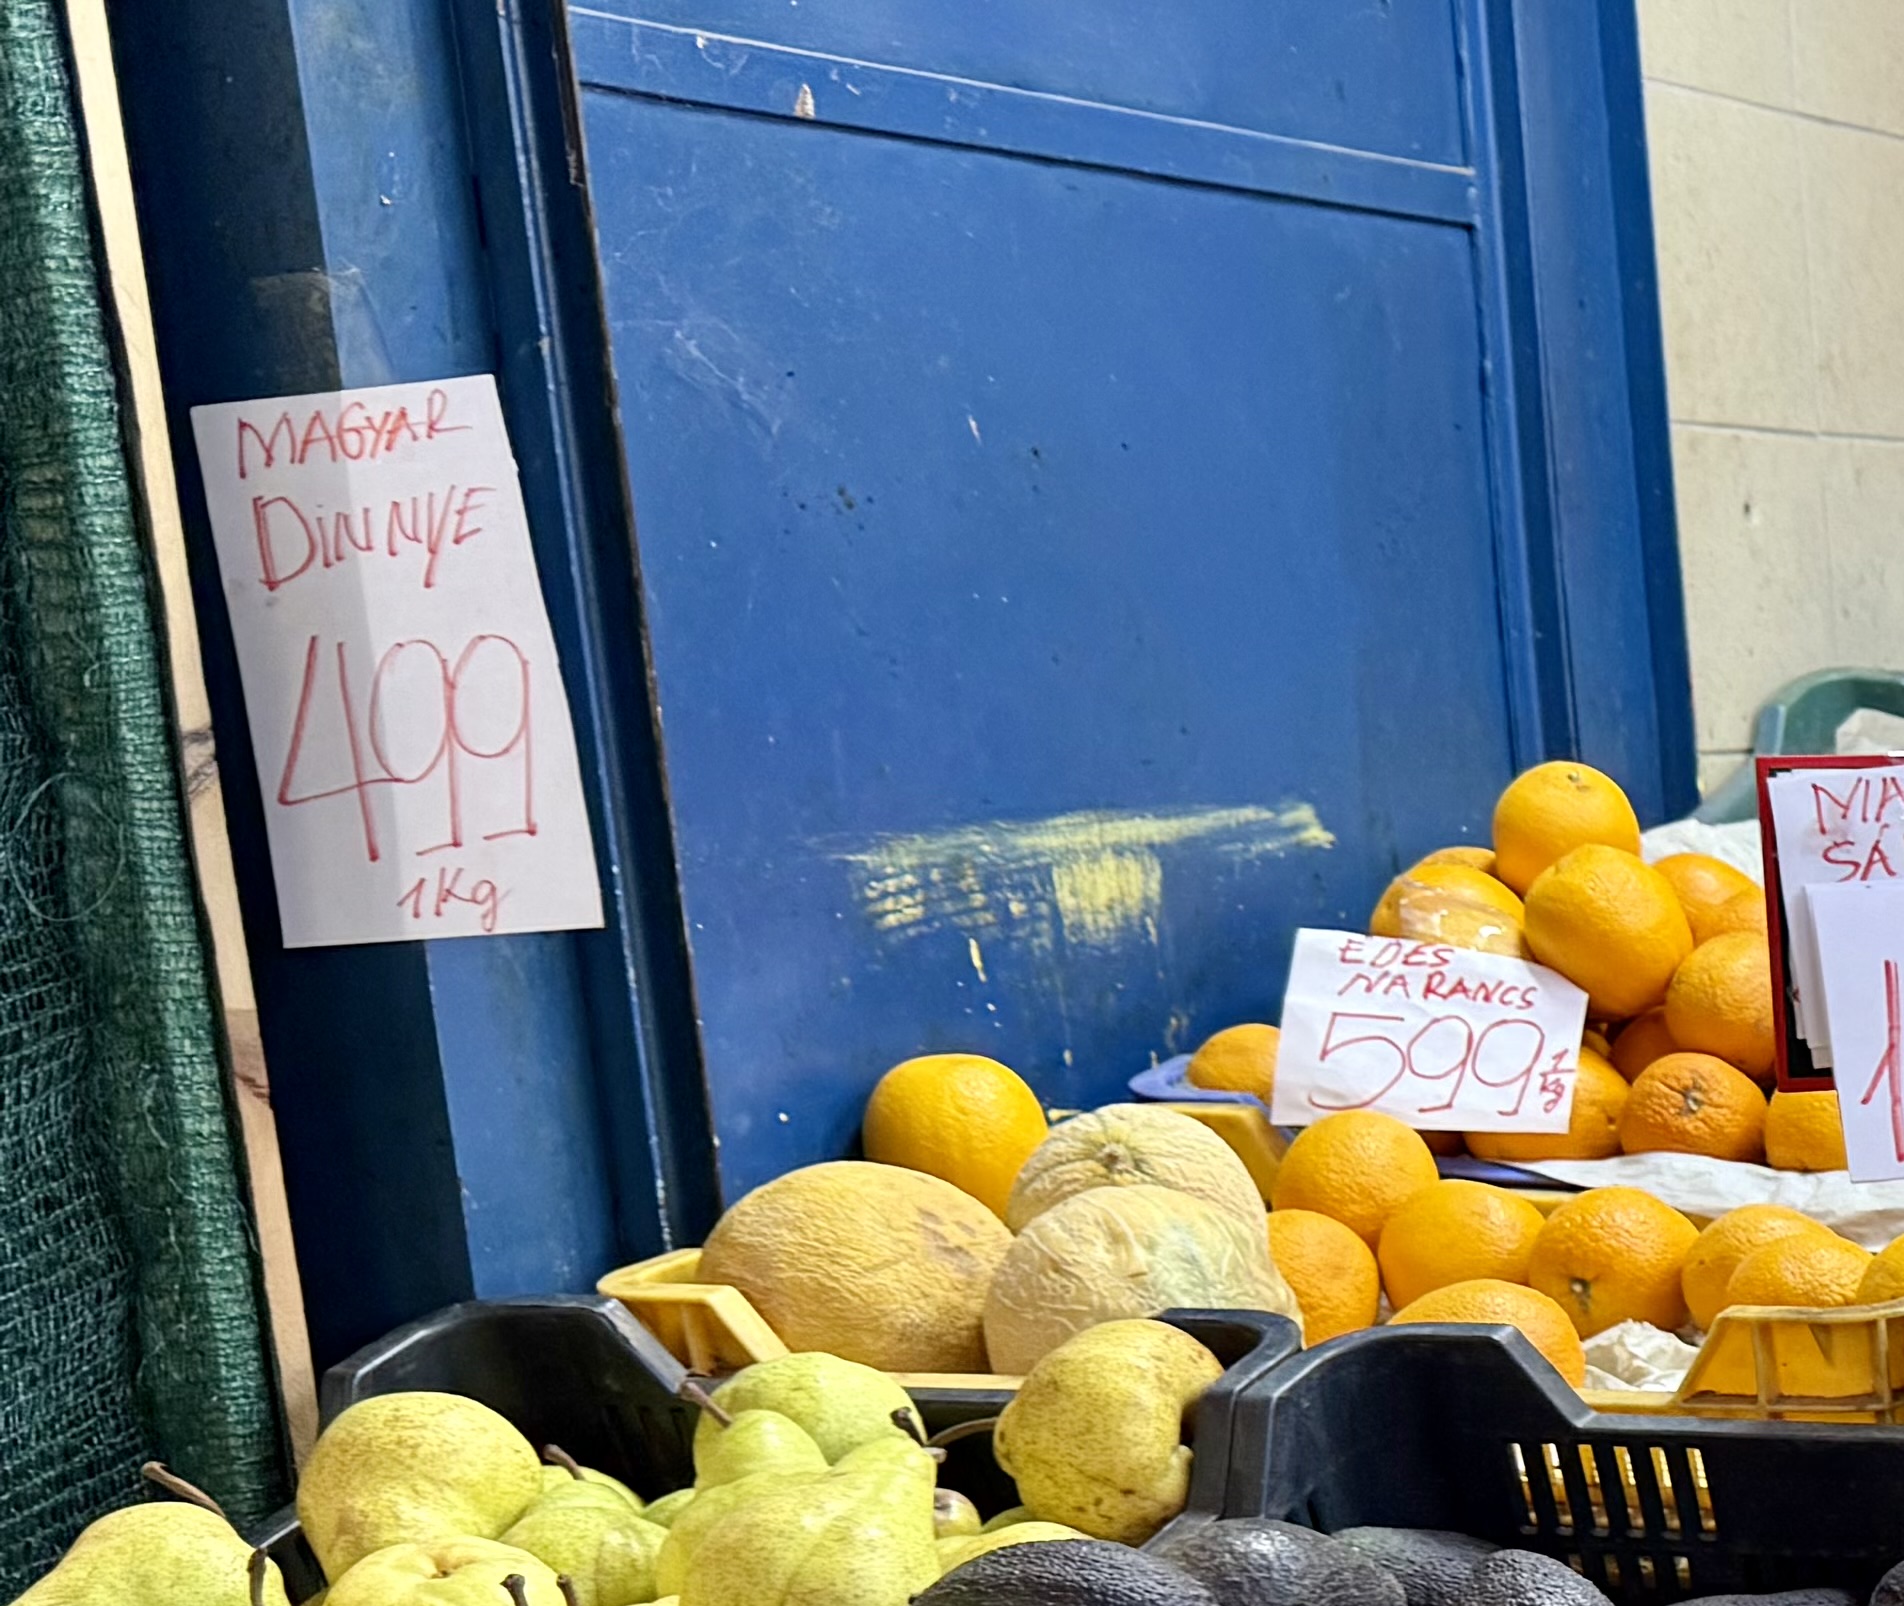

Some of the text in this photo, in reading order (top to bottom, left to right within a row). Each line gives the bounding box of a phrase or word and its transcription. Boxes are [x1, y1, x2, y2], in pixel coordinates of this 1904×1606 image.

[238, 388, 473, 479] MAGYAR
[277, 634, 538, 862] 499
[1337, 970, 1538, 1011] NARANCS
[1308, 1011, 1545, 1117] 599
